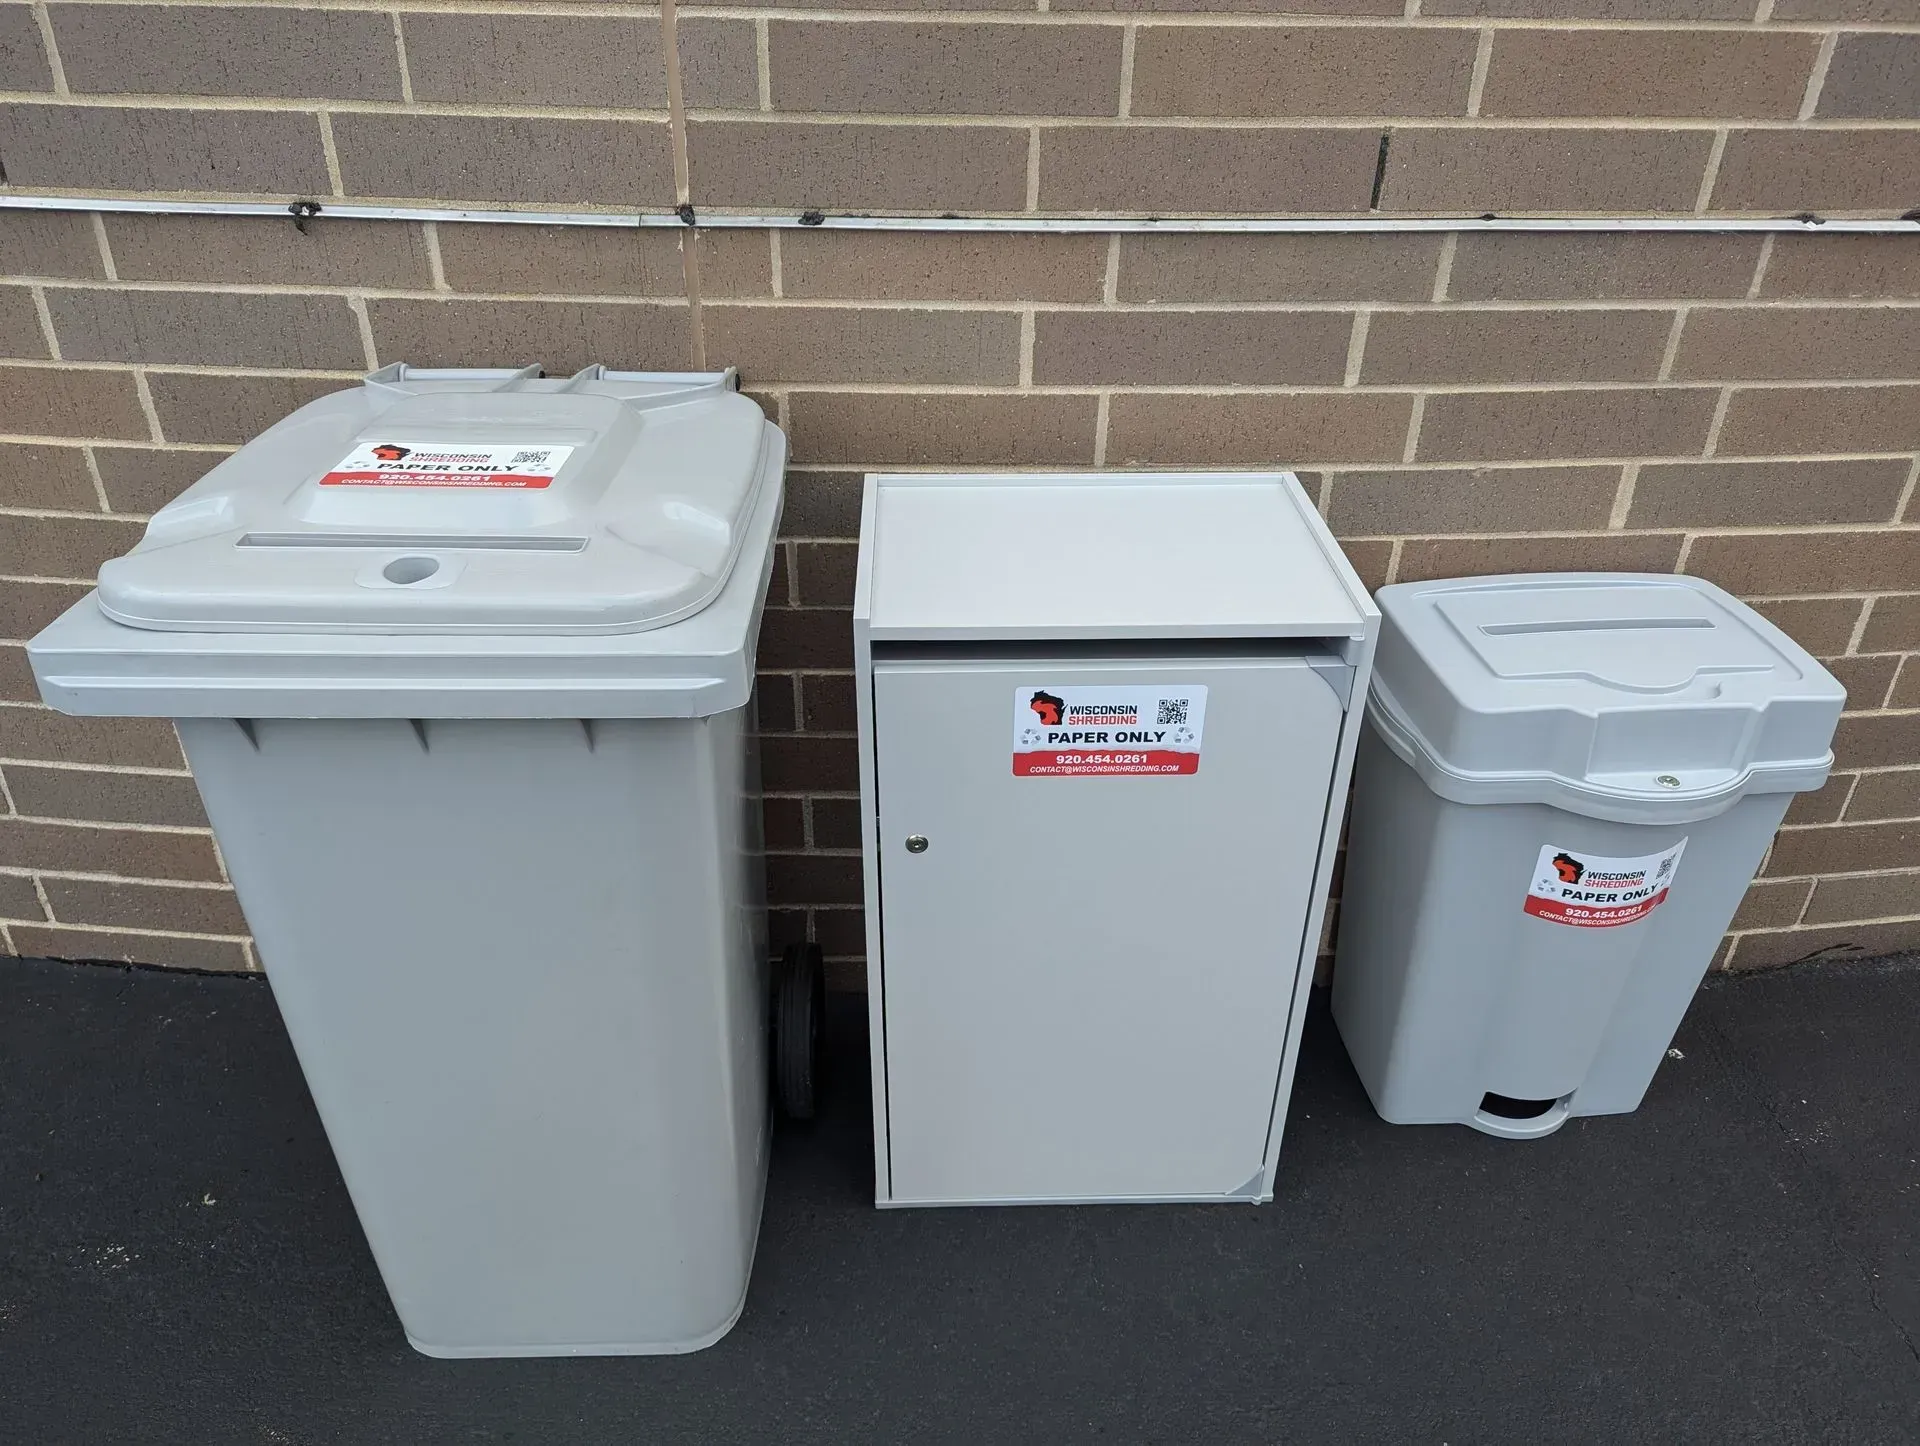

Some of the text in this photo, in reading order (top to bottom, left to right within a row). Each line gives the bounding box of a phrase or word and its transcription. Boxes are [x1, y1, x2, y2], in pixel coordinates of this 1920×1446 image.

[377, 463, 519, 472] PAPER ONLY
[341, 479, 527, 487] CONTACT@WISCONSINSHREDDING.COM
[1070, 705, 1138, 715] WISCONSIN
[1068, 715, 1137, 725] SHREDDING
[1048, 731, 1166, 744] PAPER ONLY
[1056, 754, 1148, 764] 920.454.0261
[1030, 765, 1180, 774] CONTACT@WISCONSINSHREDDING.COM
[1587, 870, 1647, 880] WISCONSIN
[1584, 878, 1645, 889] SHREDDING
[1561, 883, 1659, 903] PAPER ONLY
[1565, 905, 1643, 919] 920.454.0261
